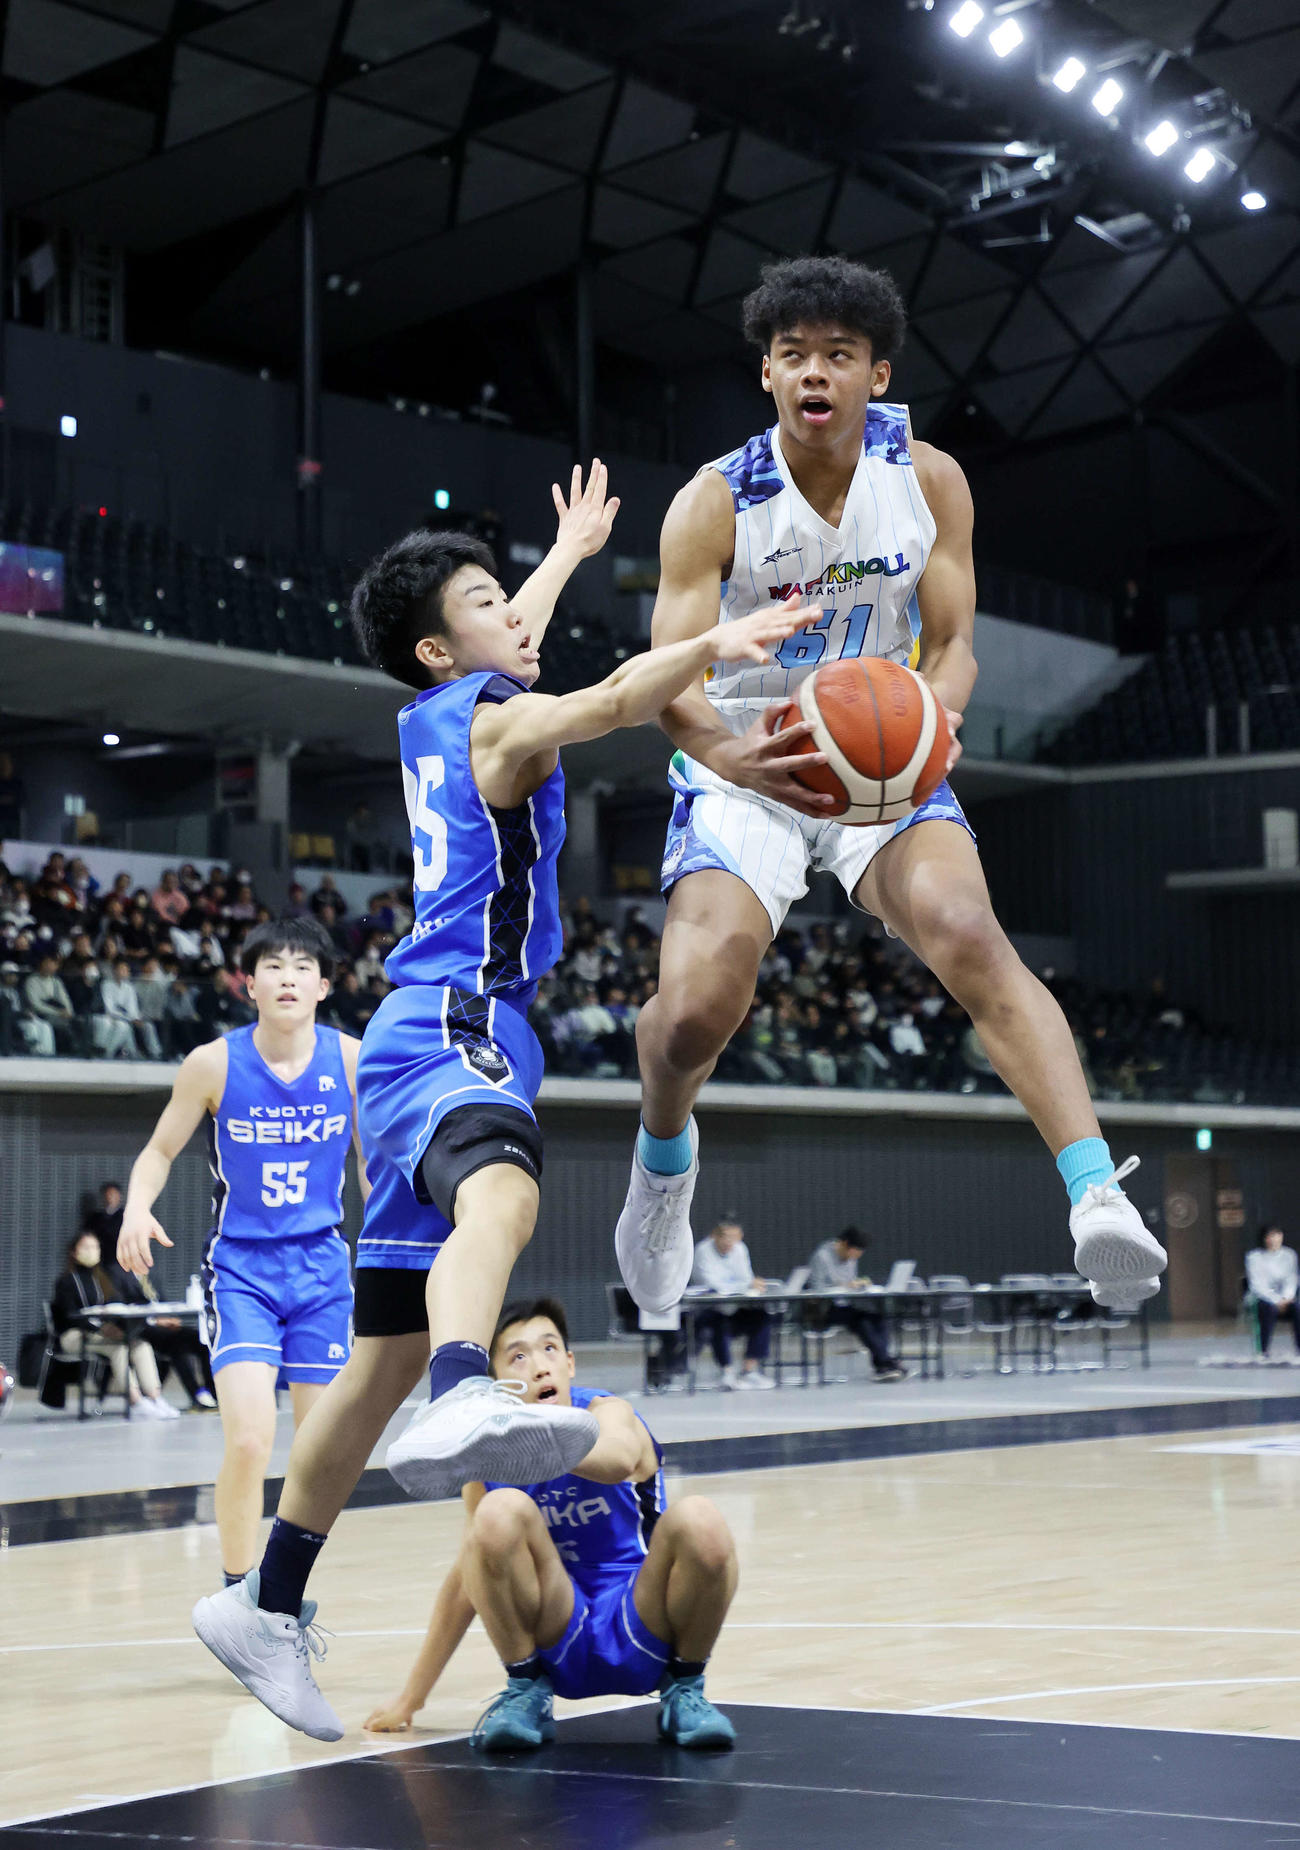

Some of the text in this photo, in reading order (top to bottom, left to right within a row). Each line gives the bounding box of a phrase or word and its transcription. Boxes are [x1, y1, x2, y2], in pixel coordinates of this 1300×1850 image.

[768, 552, 911, 602] MAKNOLL
[775, 603, 874, 670] 61
[226, 1113, 348, 1144] SEIKA
[249, 1103, 328, 1118] KYOTO
[261, 1160, 311, 1208] 55
[541, 1496, 612, 1528] IKA
